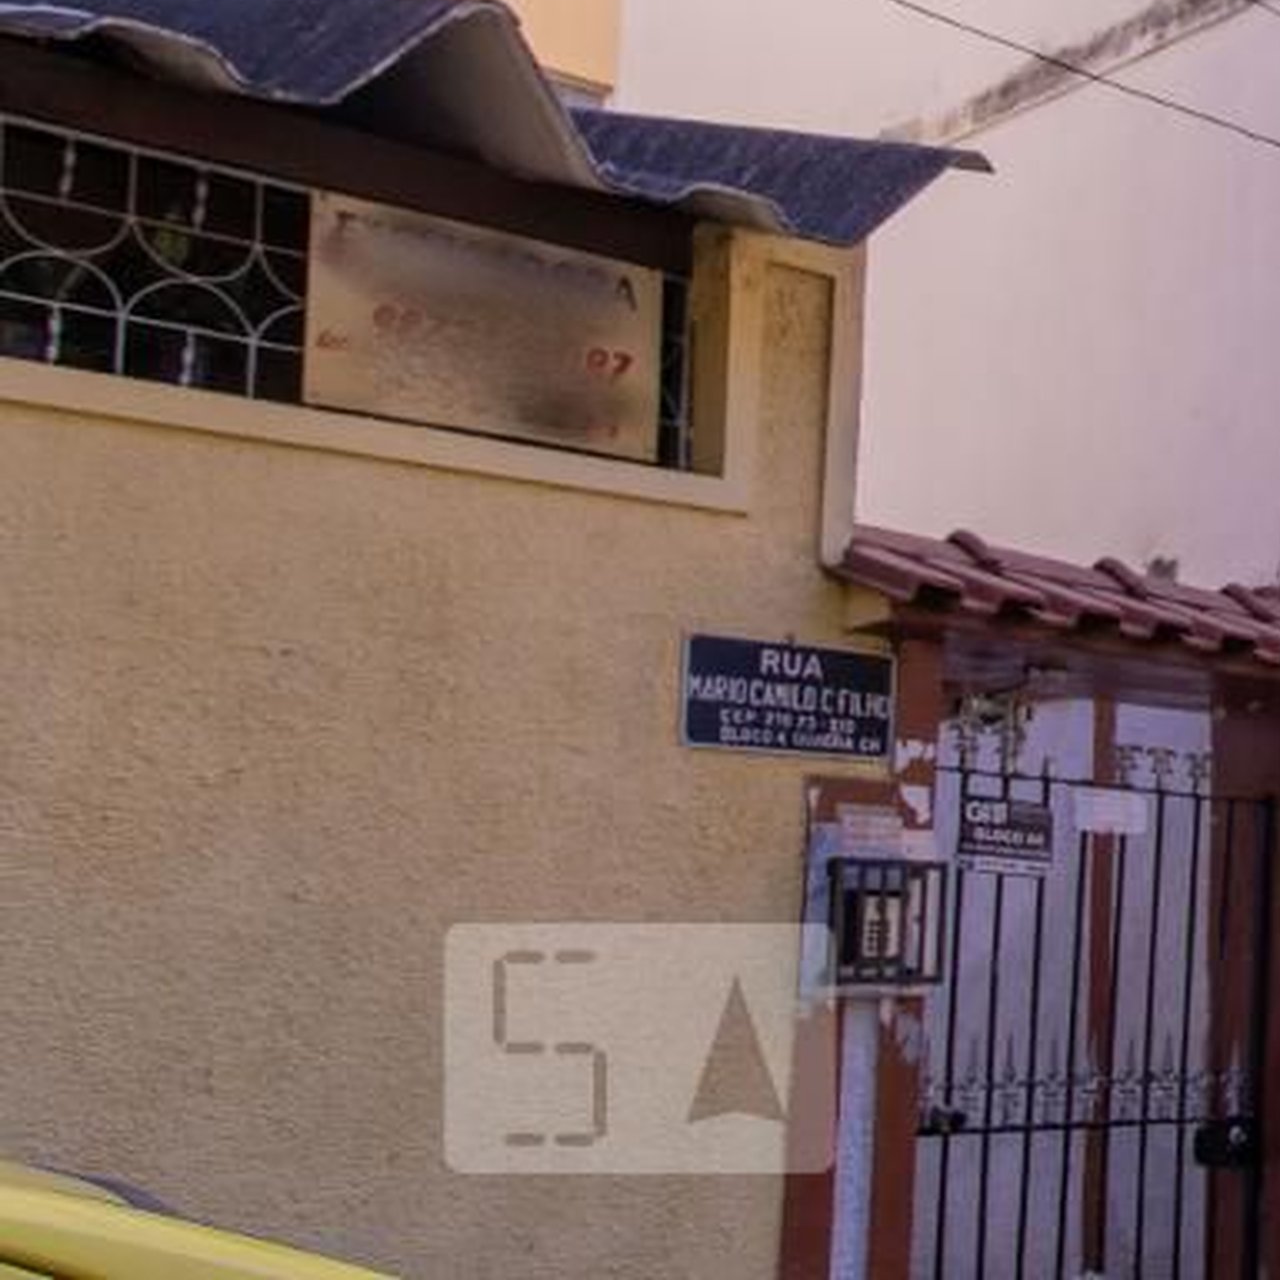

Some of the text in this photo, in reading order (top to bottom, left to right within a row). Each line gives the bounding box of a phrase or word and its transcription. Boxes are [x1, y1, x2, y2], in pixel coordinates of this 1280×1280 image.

[760, 650, 824, 680] RUA
[688, 673, 748, 705] MARIO
[837, 689, 891, 719] FILHO
